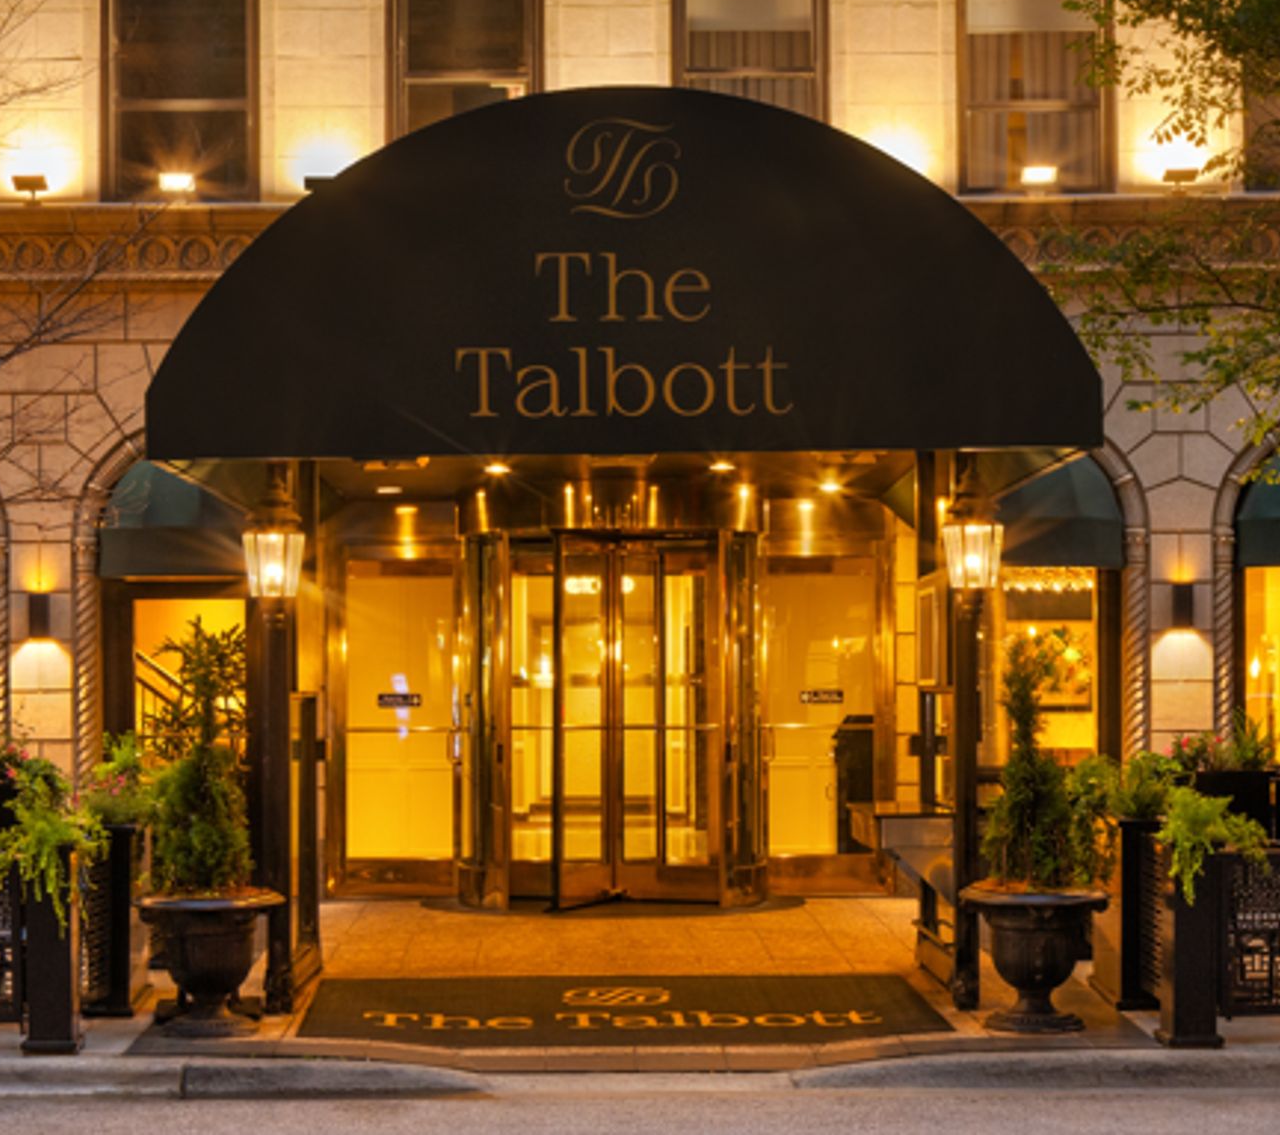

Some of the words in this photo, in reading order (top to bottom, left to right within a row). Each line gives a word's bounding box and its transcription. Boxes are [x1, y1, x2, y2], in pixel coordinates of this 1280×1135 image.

[534, 251, 712, 323] The
[454, 346, 794, 418] Talbott
[362, 1010, 534, 1030] The
[554, 1009, 883, 1030] Talbott
